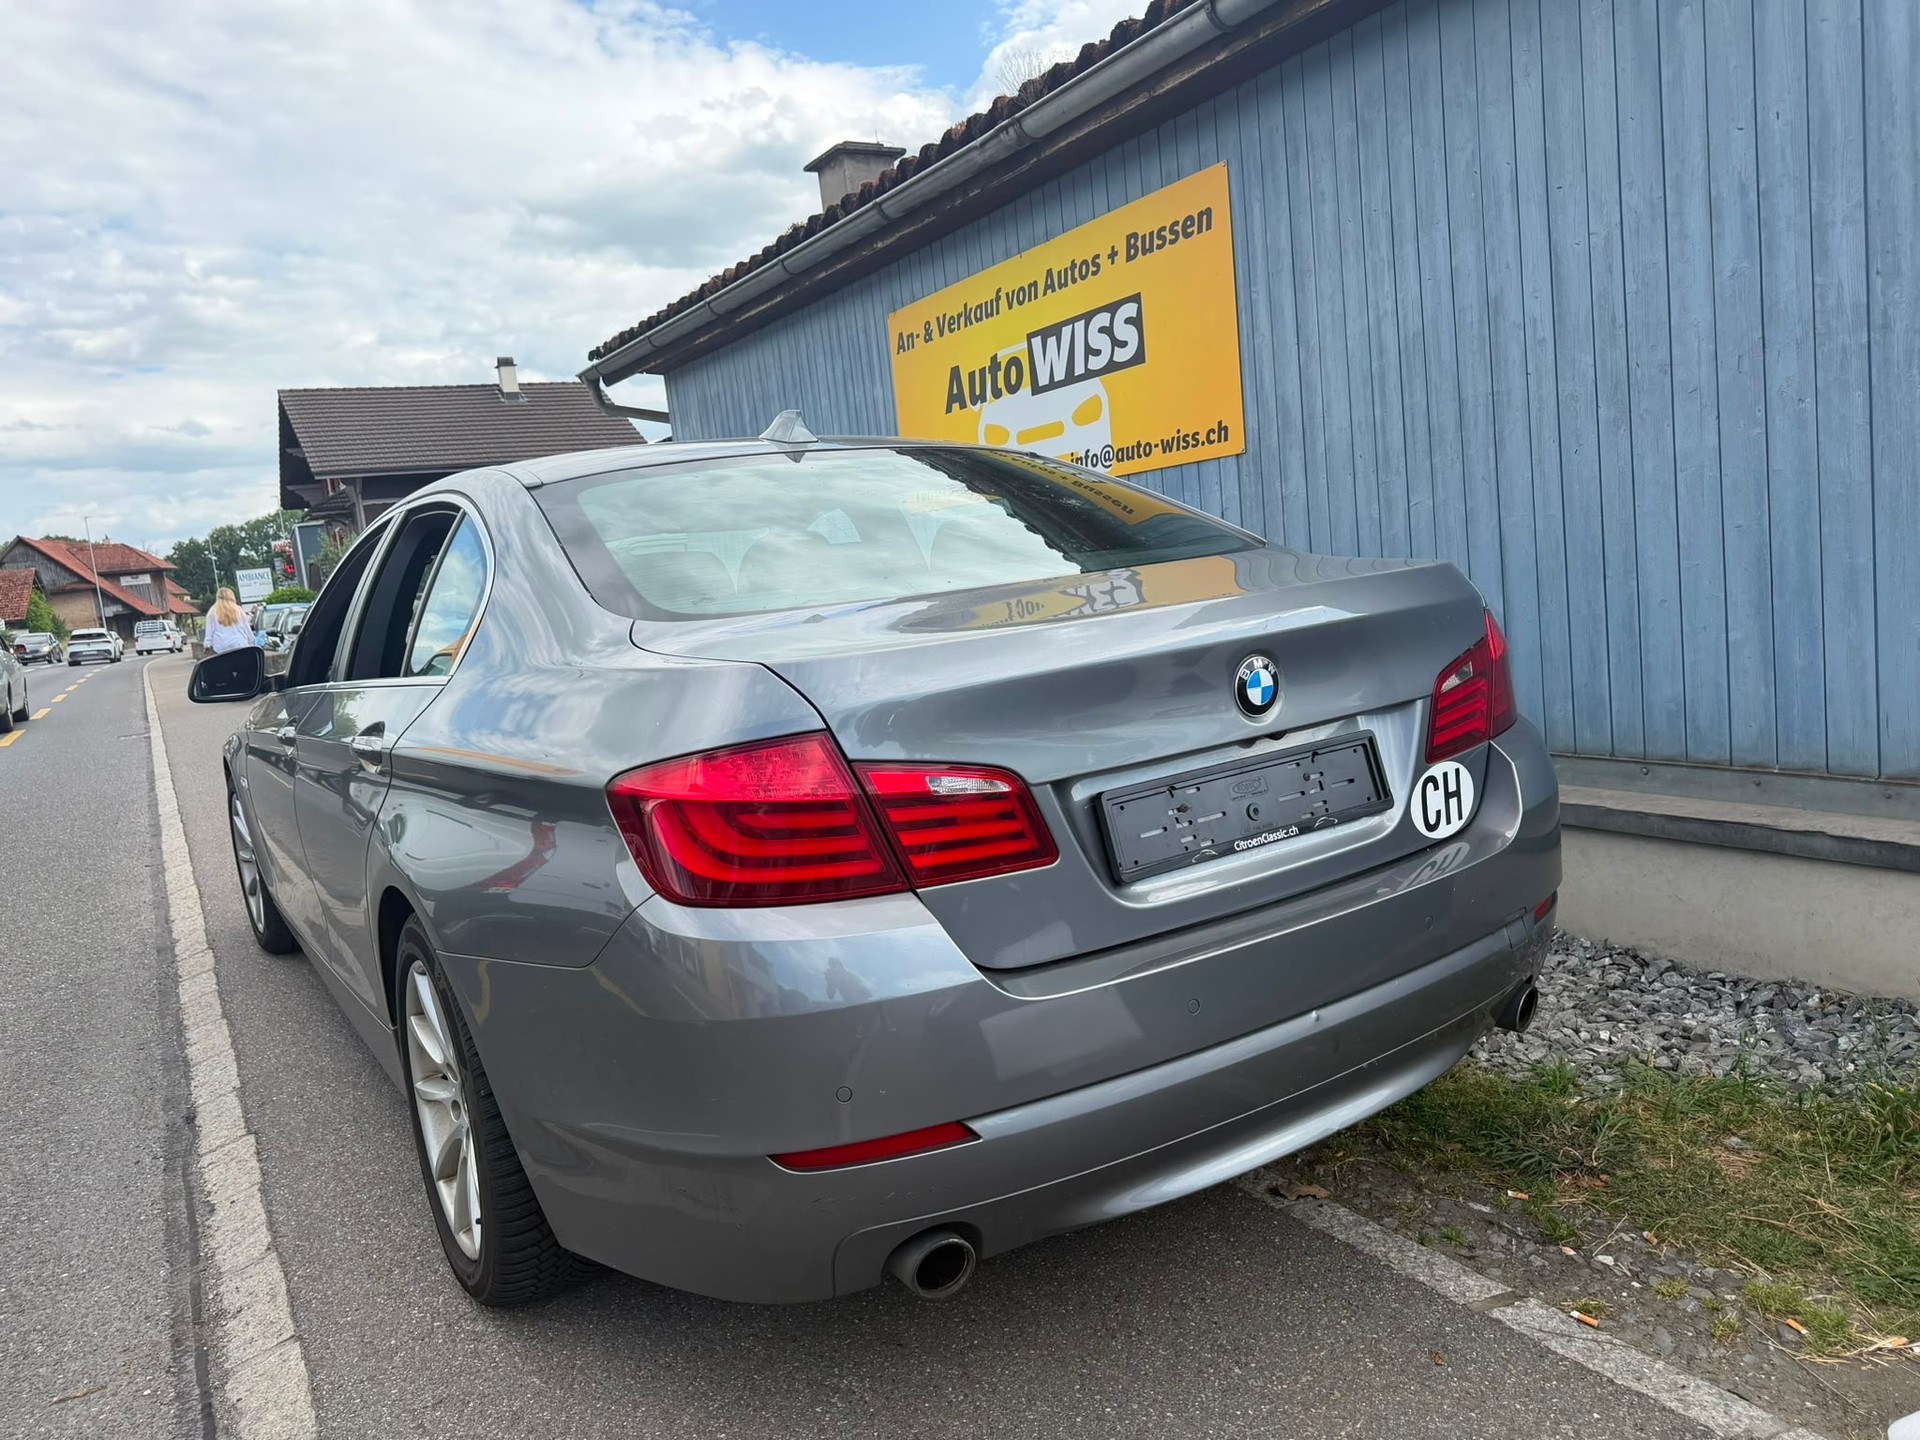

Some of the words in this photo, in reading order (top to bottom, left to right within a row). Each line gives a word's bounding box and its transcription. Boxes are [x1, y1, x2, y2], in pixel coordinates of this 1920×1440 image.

[897, 331, 920, 355] An-
[924, 320, 934, 343] &
[936, 287, 1002, 339] Verkauf
[1005, 279, 1039, 311] von
[1042, 253, 1101, 298] Autos
[1107, 245, 1119, 265] +
[1126, 206, 1213, 263] Bussen
[945, 353, 1024, 415] Auto
[1030, 302, 1140, 388] WISS
[1070, 420, 1229, 468] info@auto-wiss.ch
[1240, 658, 1276, 681] BMW
[1421, 767, 1463, 833] CH
[1233, 825, 1300, 851] CitroenClassic.ch
